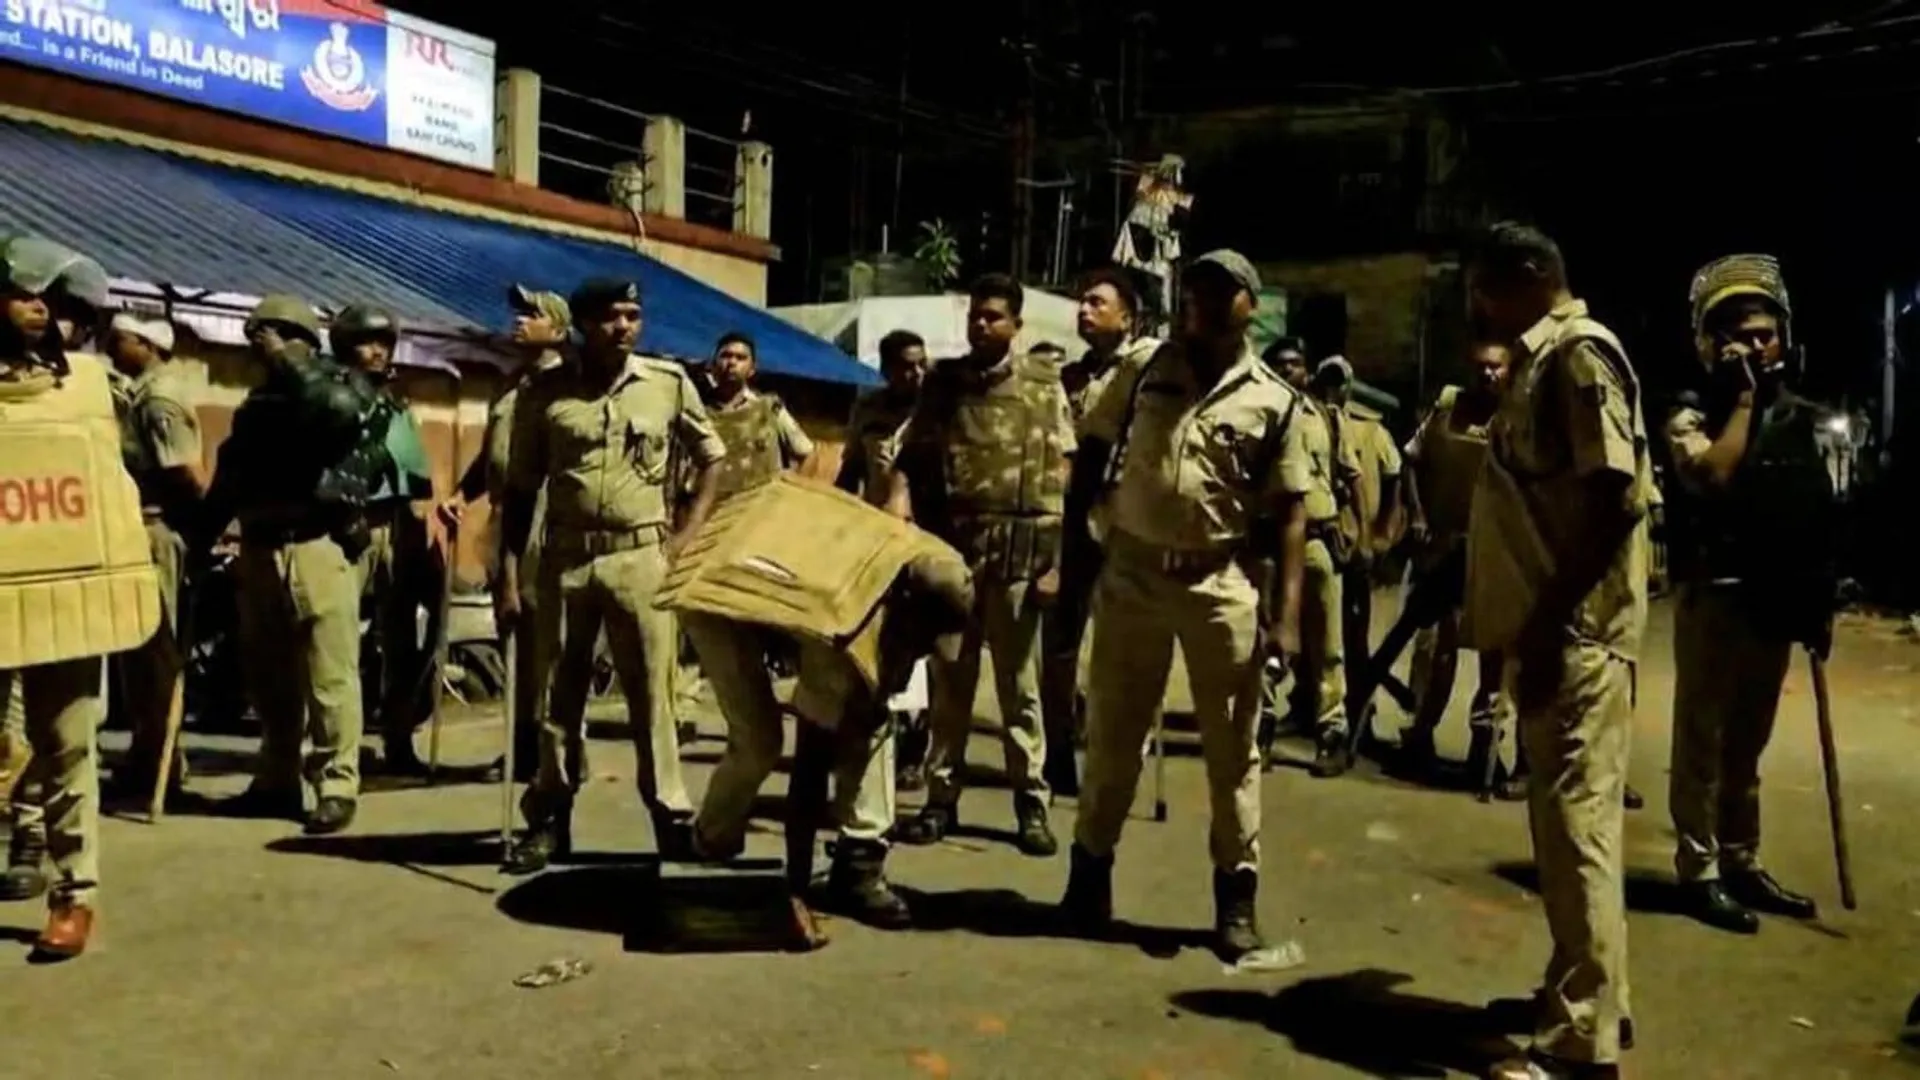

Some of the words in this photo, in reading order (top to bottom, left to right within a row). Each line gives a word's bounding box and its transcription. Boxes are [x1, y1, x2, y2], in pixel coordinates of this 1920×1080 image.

[64, 45, 75, 60] a
[80, 45, 137, 75] Friend
[162, 68, 203, 90] Deed
[148, 31, 285, 90] BALASORE
